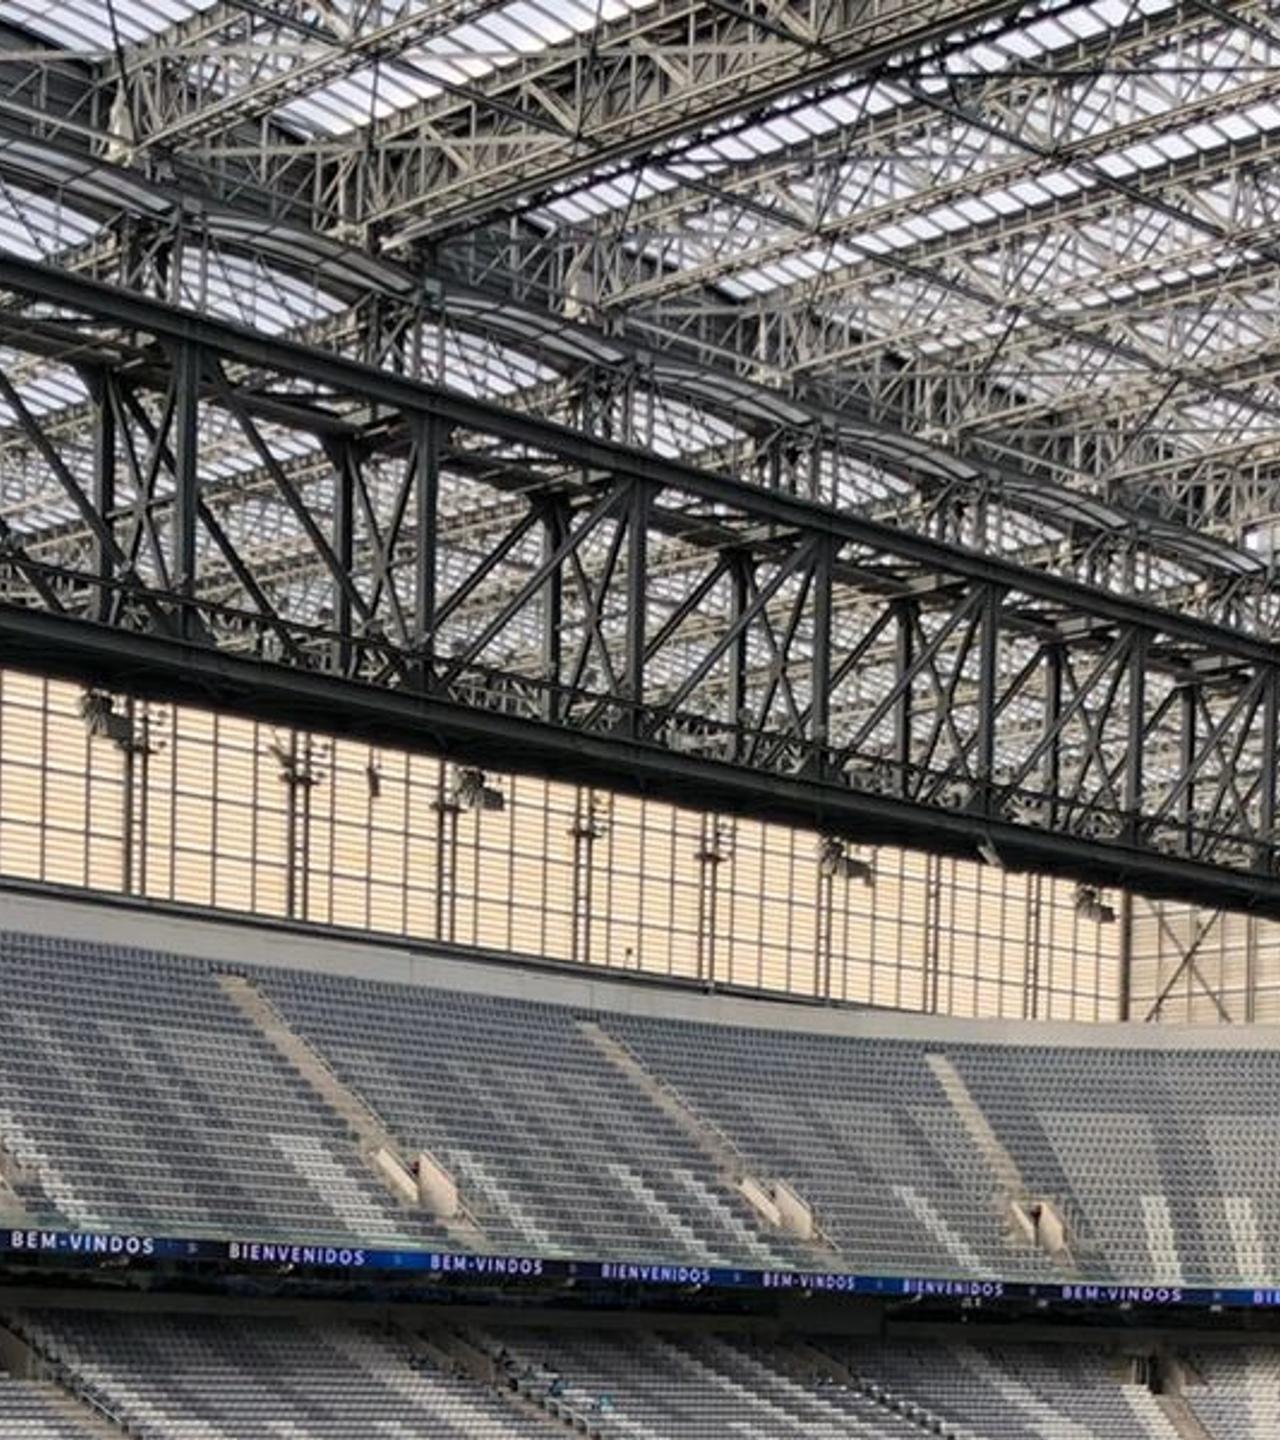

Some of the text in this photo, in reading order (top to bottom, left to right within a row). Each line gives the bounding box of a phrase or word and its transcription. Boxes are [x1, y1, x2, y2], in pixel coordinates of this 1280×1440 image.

[11, 1232, 154, 1254] BEM-VINDOS
[230, 1243, 365, 1265] BIENVENIDOS
[431, 1255, 543, 1275] BEM-VINDOS
[602, 1265, 710, 1283] BIENVENIDOS
[763, 1273, 856, 1290] BEM-VINDOS
[1062, 1286, 1183, 1301] BEM-VINDOS
